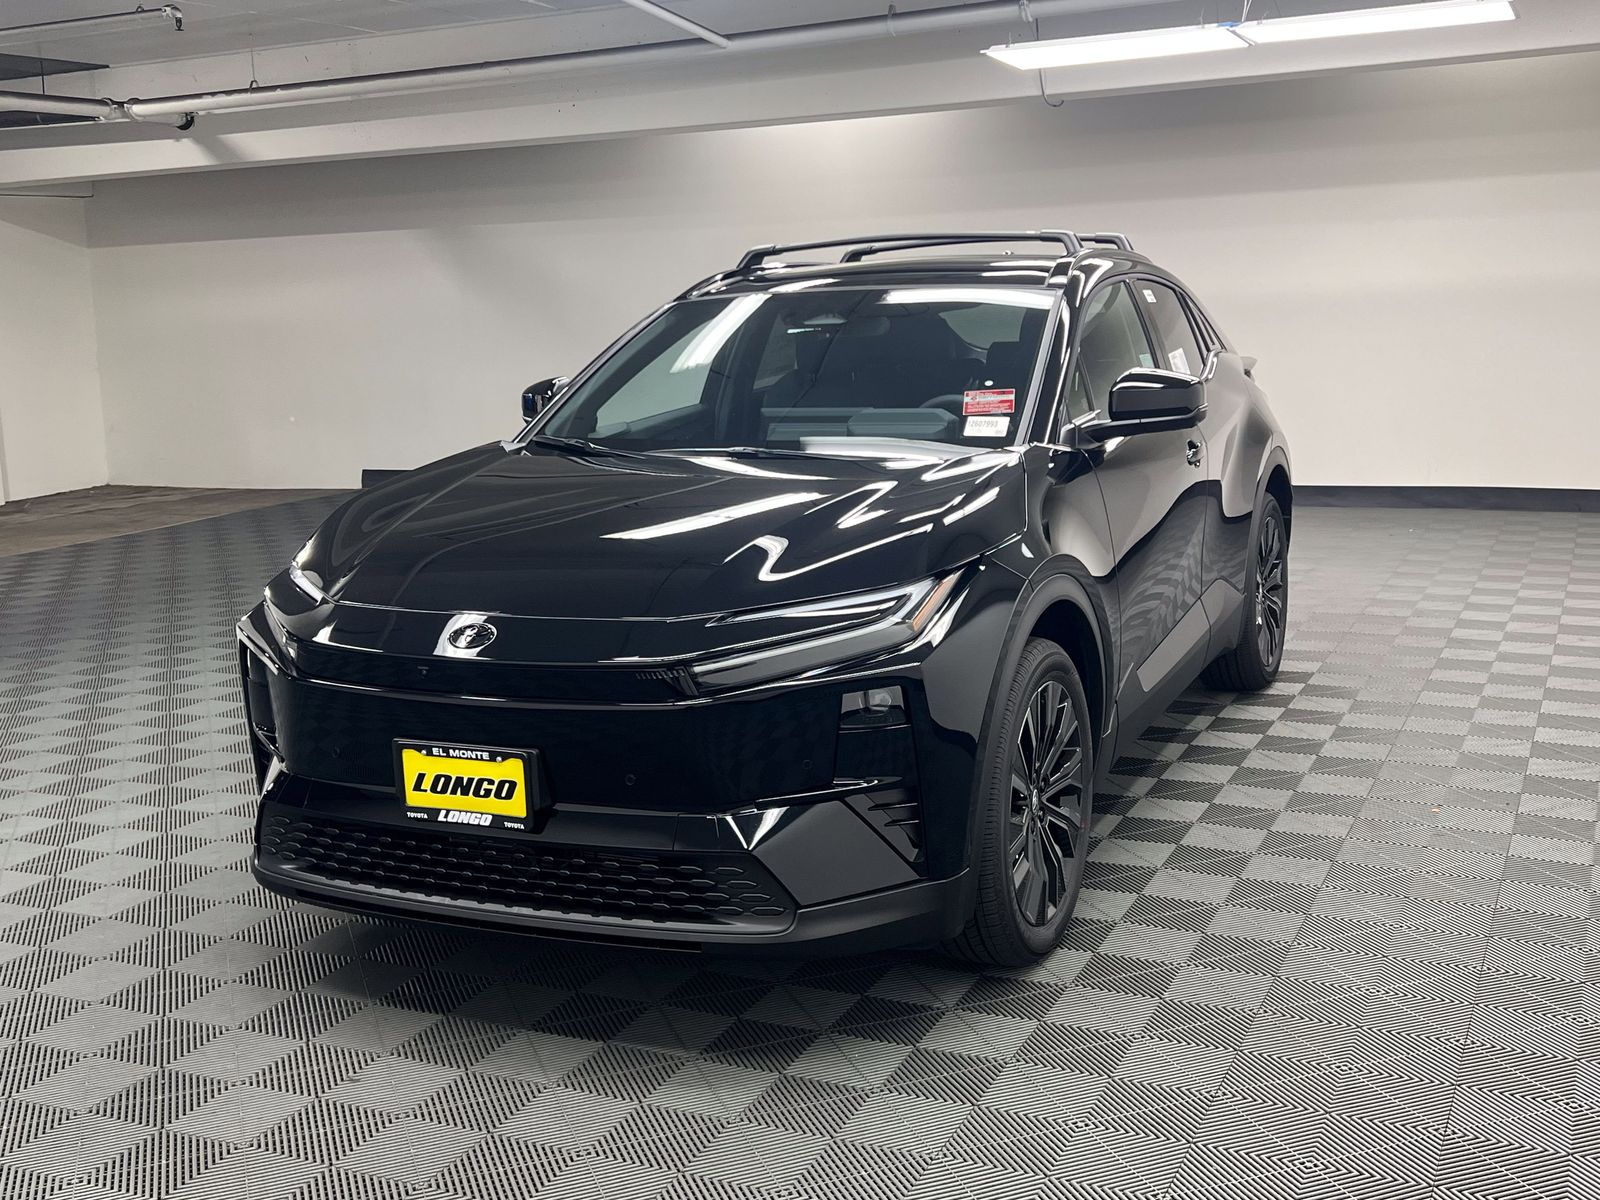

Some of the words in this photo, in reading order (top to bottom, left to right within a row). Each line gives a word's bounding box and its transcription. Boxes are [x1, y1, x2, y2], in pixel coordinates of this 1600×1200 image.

[432, 747, 446, 756] EL
[449, 749, 490, 760] MONTE
[412, 772, 518, 800] LONGO
[406, 811, 428, 819] TOYOTA
[437, 810, 493, 826] LONGO
[503, 821, 525, 830] TOYOTA
